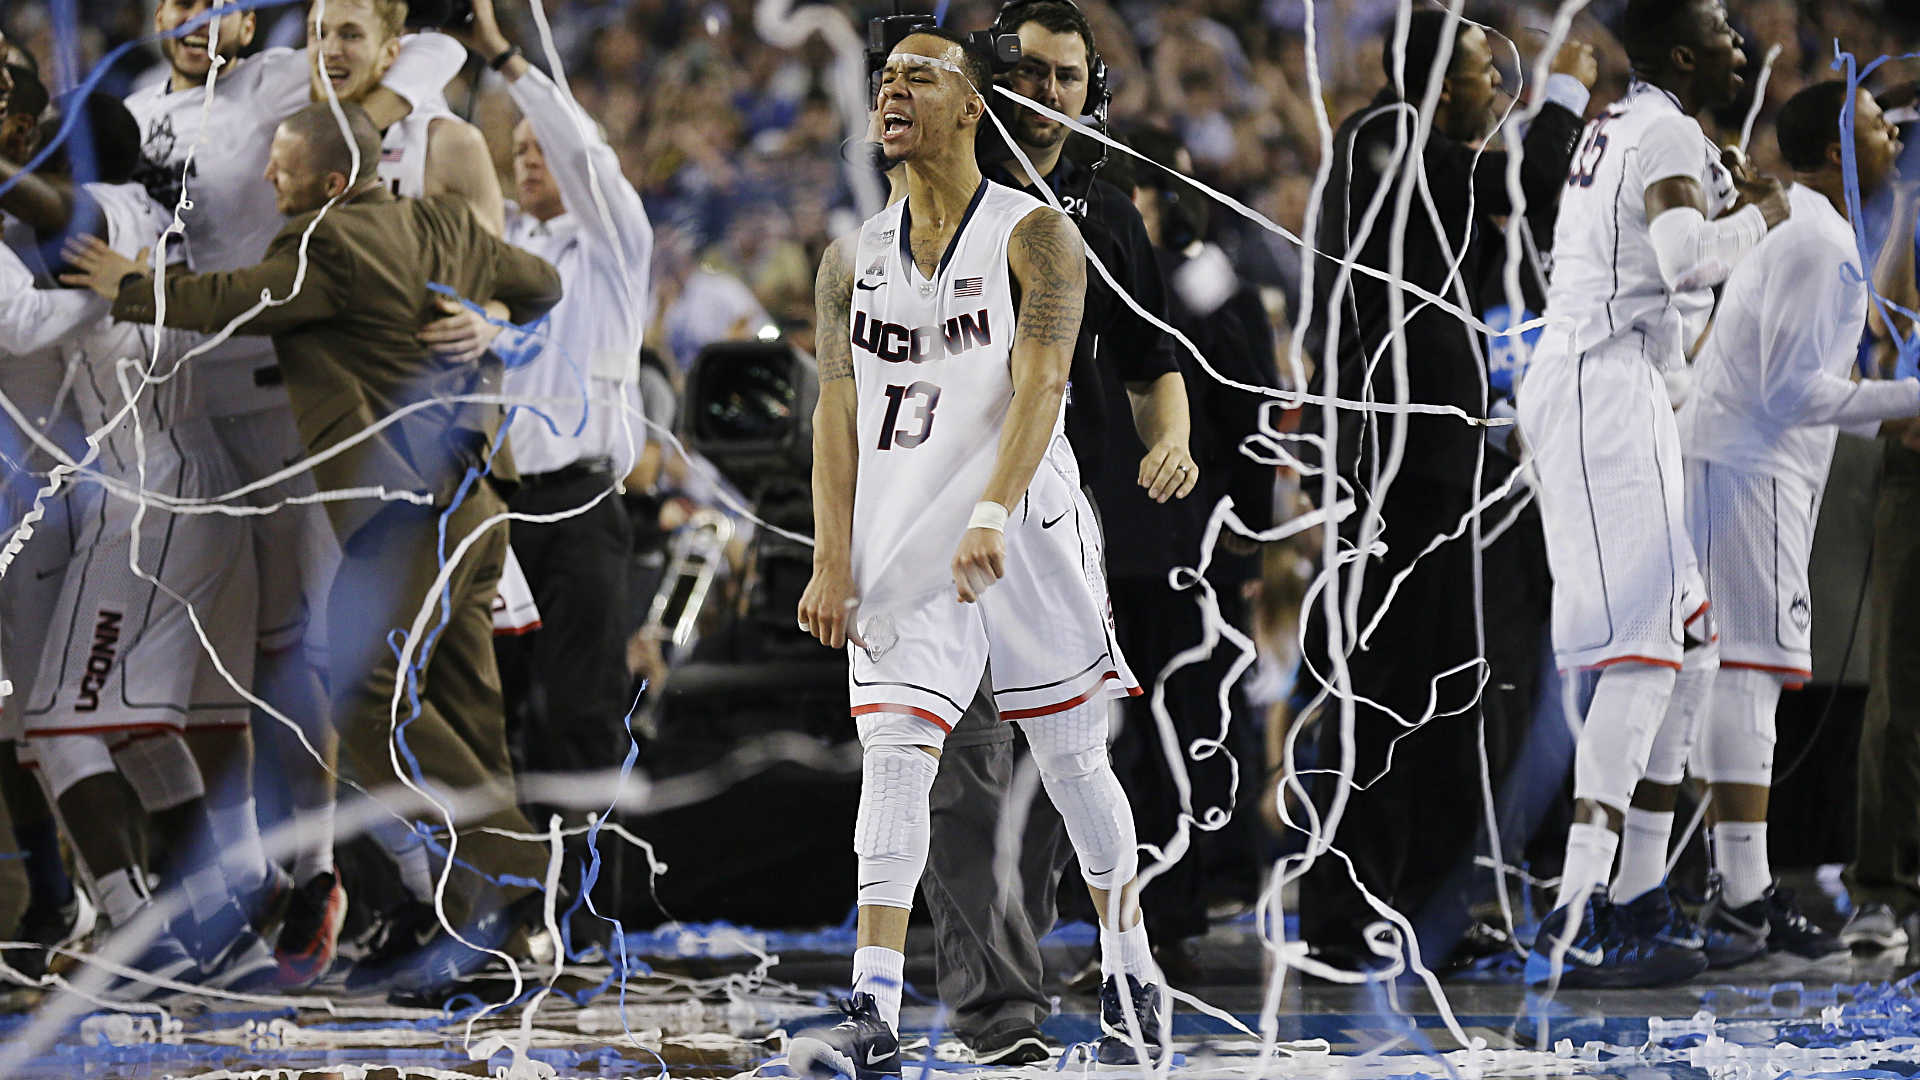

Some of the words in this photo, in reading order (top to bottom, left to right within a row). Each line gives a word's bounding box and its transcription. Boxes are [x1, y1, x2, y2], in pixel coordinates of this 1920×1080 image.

[852, 309, 992, 364] UCONN
[877, 381, 941, 451] 13
[74, 609, 123, 713] UCONN
